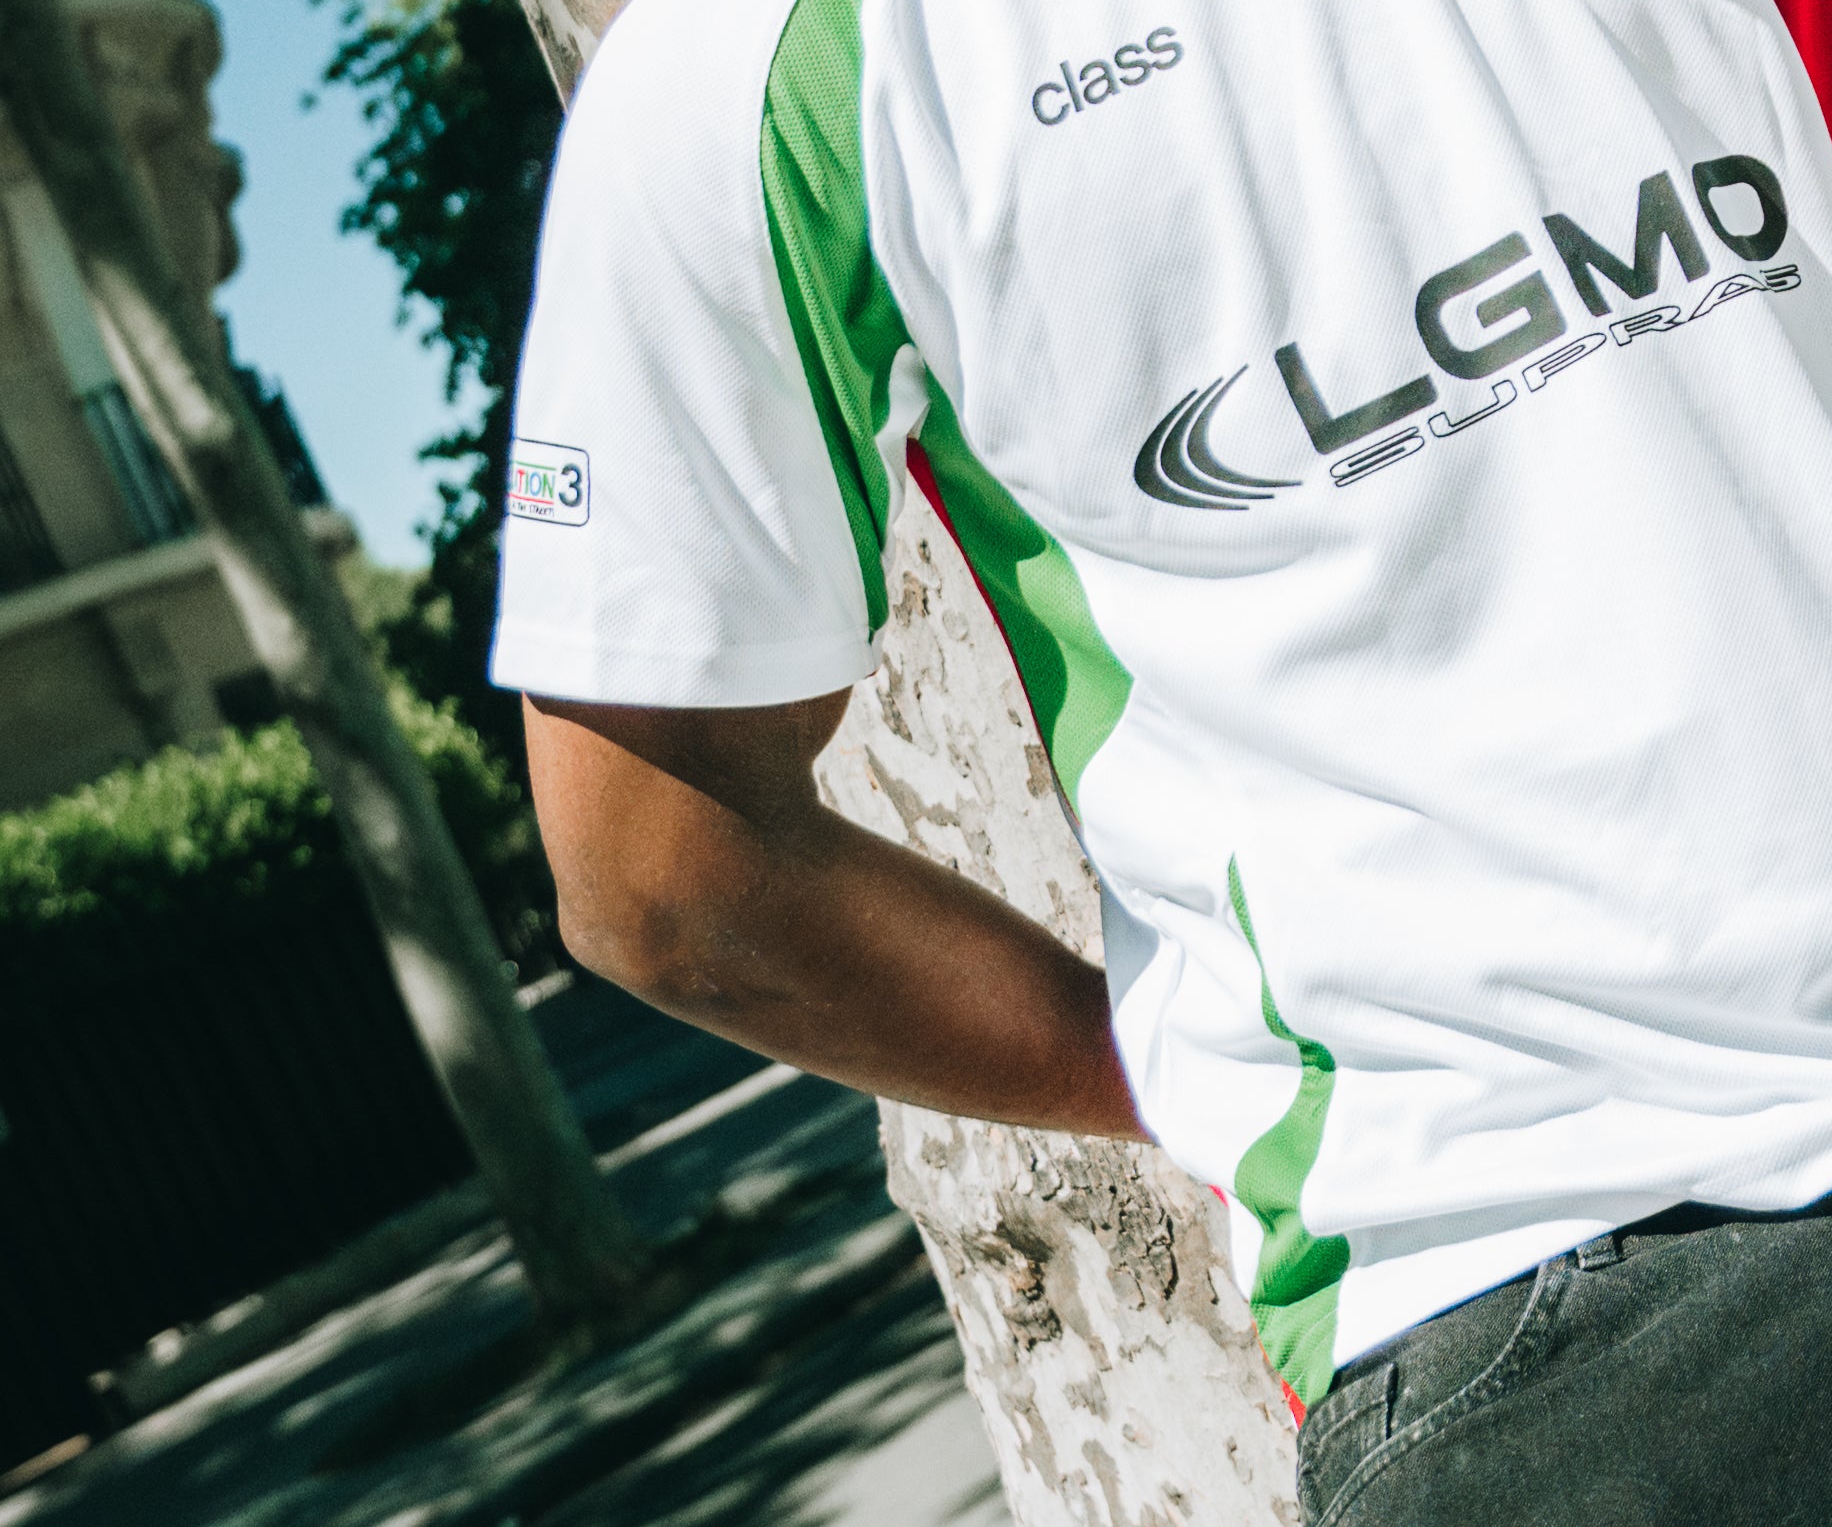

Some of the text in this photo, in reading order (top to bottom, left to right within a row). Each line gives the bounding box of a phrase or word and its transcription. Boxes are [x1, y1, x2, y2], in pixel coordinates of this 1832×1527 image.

[1031, 25, 1185, 127] class
[1273, 153, 1788, 456] LGMO
[1329, 264, 1802, 488] SUPRAS
[514, 463, 583, 508] TION 3
